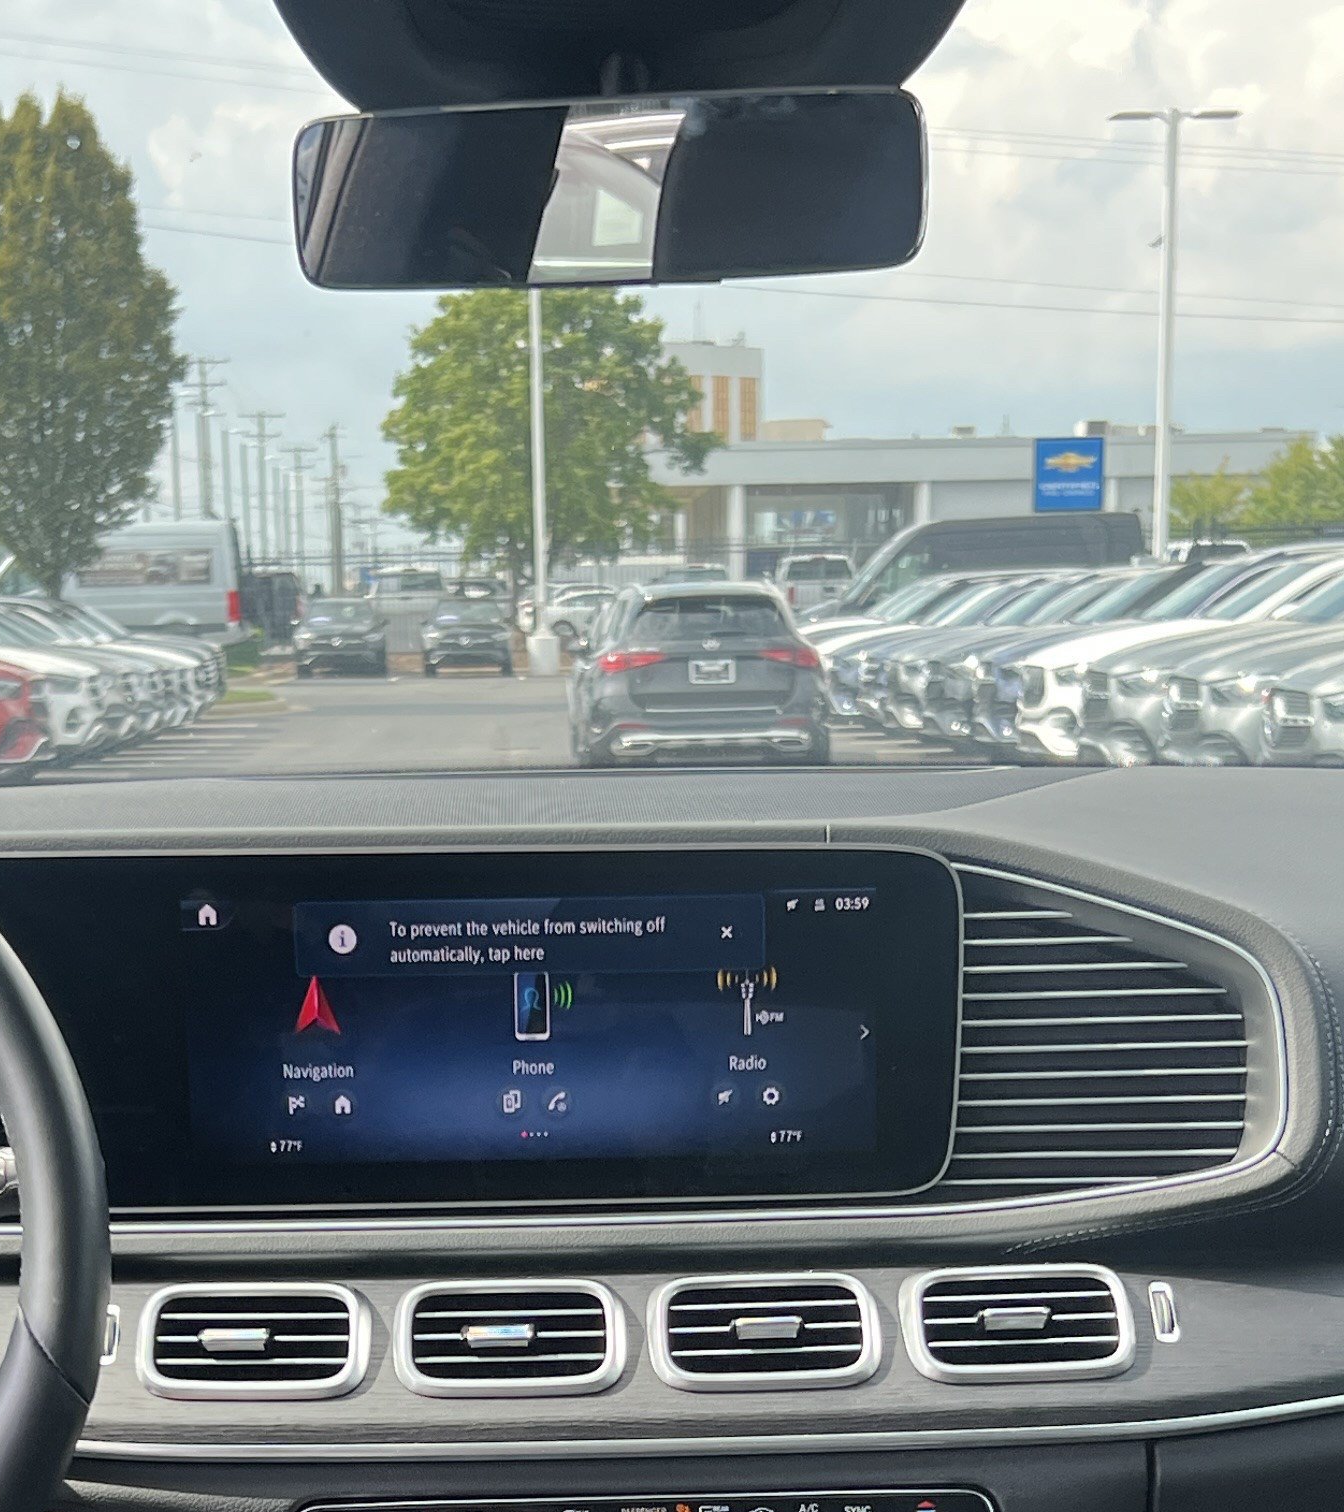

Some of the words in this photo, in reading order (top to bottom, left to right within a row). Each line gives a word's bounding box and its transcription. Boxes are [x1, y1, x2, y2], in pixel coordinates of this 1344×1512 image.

[835, 897, 870, 911] 03:59
[389, 921, 406, 937] To
[410, 921, 462, 940] prevent
[466, 920, 488, 936] the
[492, 919, 540, 935] vehicle
[544, 918, 576, 935] from
[579, 917, 643, 937] switching
[646, 916, 666, 933] off
[390, 946, 485, 965] automatically,
[488, 947, 511, 964] tap
[514, 946, 545, 961] here
[512, 1060, 555, 1076] Phone
[729, 1055, 767, 1071] Radio
[282, 1063, 354, 1082] Navigation
[779, 1130, 802, 1142] 77°F
[279, 1140, 303, 1152] 77°F
